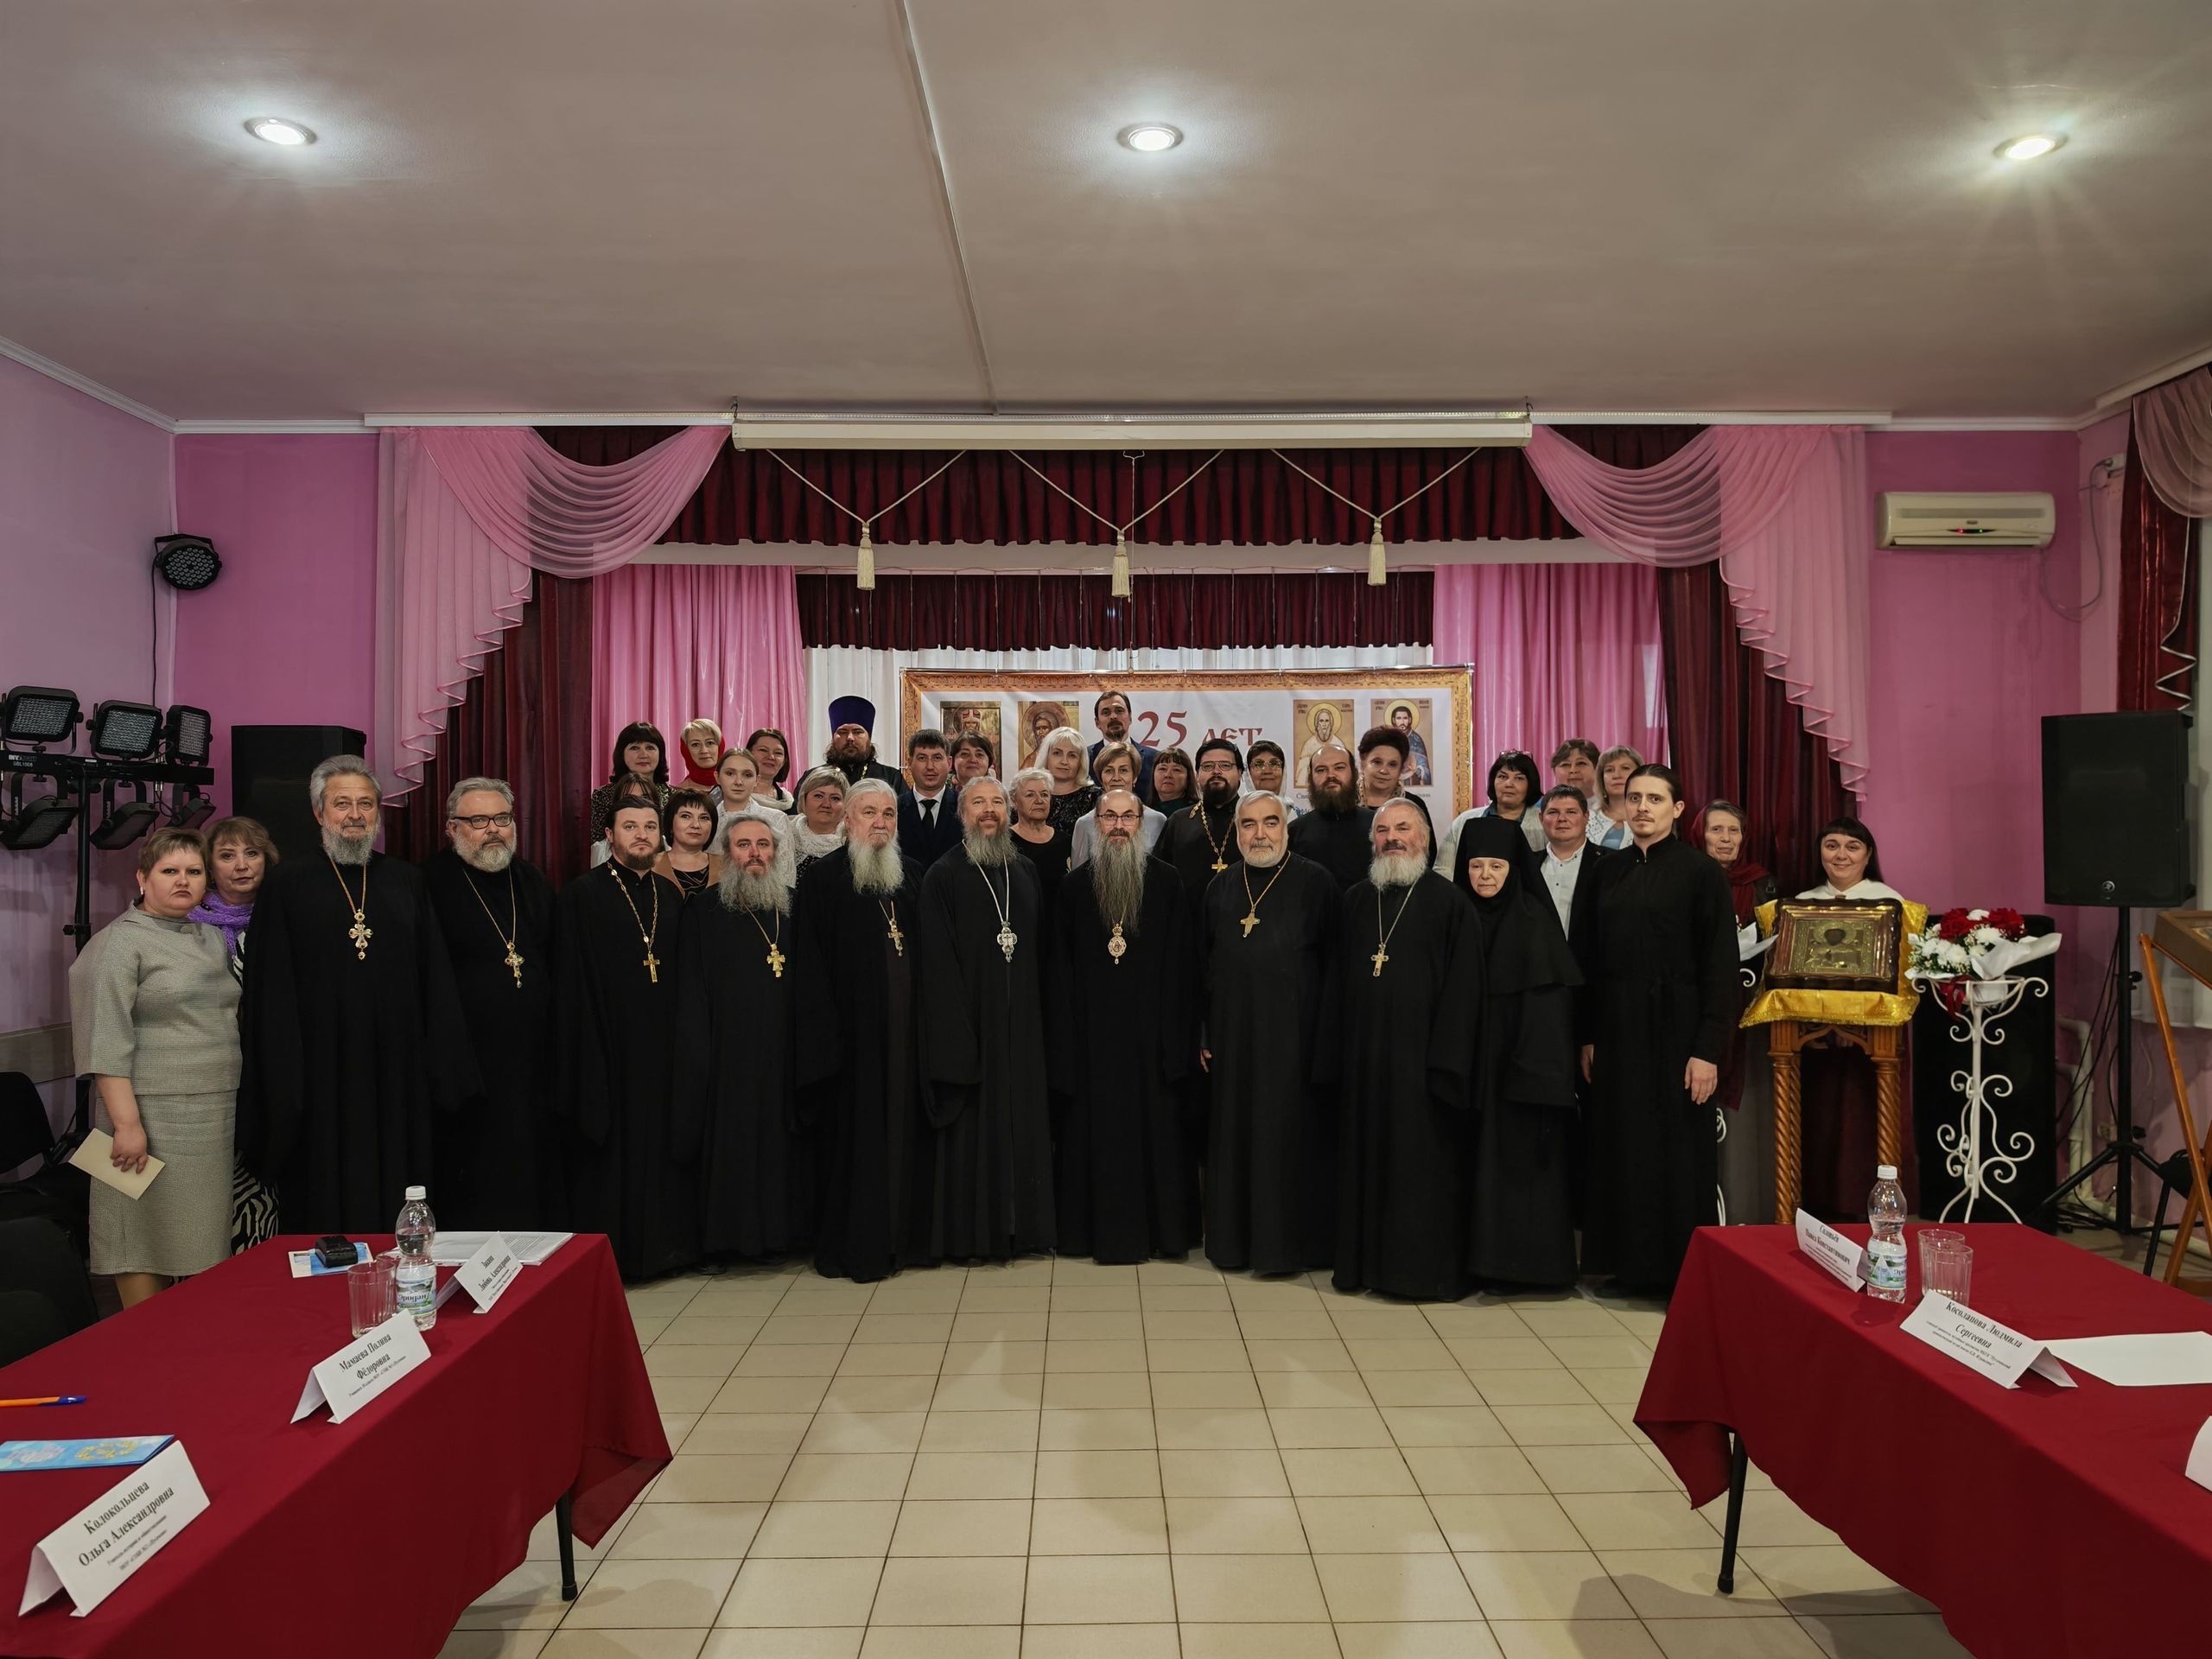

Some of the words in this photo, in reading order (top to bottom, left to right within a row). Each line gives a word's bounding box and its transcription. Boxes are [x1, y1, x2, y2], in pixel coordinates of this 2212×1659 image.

[1137, 710, 1187, 747] 25
[1946, 1301, 1987, 1329] Косолапова
[1986, 1325, 2023, 1348] Людмила
[1955, 1324, 1992, 1348] Сергеевна
[340, 1350, 369, 1372] Мамаева
[367, 1334, 391, 1353] Полина
[357, 1354, 391, 1379] Фёдоровна
[79, 1539, 111, 1566] Ольга
[111, 1487, 174, 1542] Александровна
[84, 1482, 149, 1535] Колокольцева
